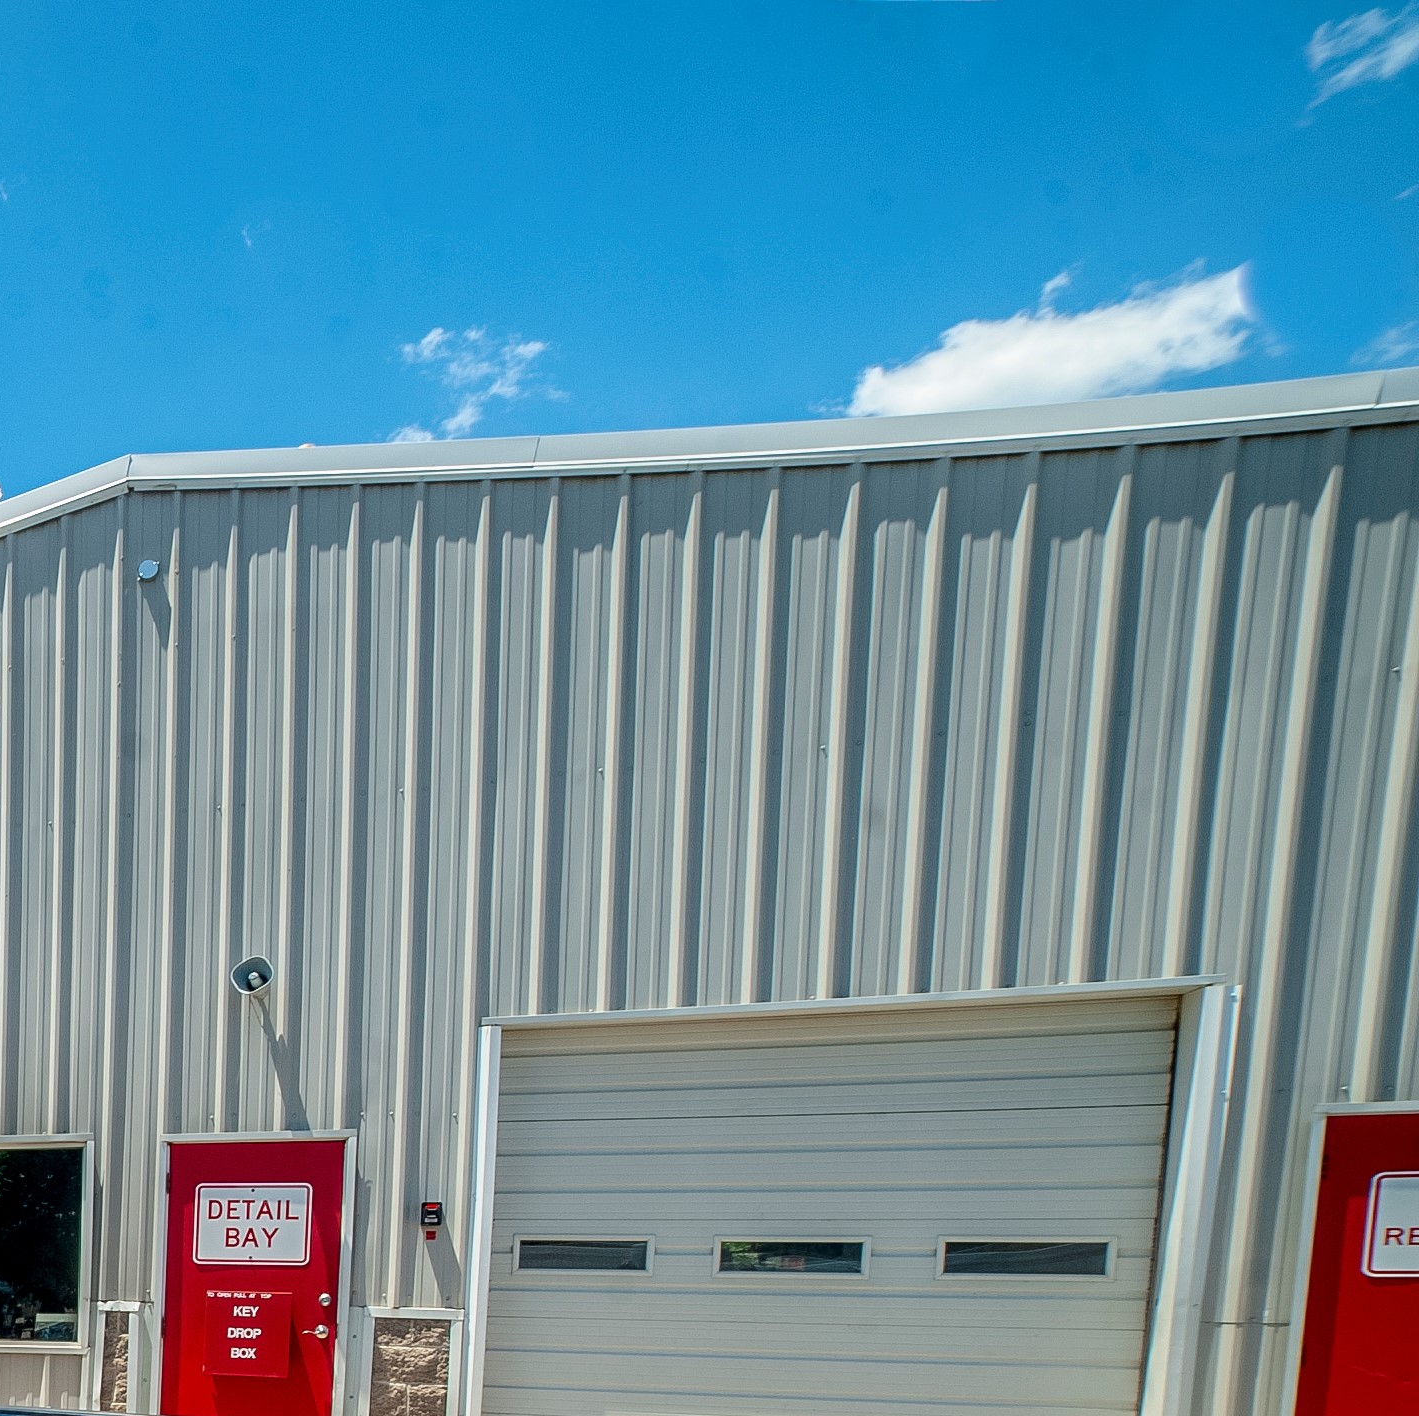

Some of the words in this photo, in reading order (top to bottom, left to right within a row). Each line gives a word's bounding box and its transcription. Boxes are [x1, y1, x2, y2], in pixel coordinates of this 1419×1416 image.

[208, 1199, 299, 1220] DETAIL
[225, 1227, 279, 1248] BAY
[233, 1305, 259, 1317] KEY
[227, 1327, 262, 1339] DROP
[230, 1347, 257, 1359] BOX
